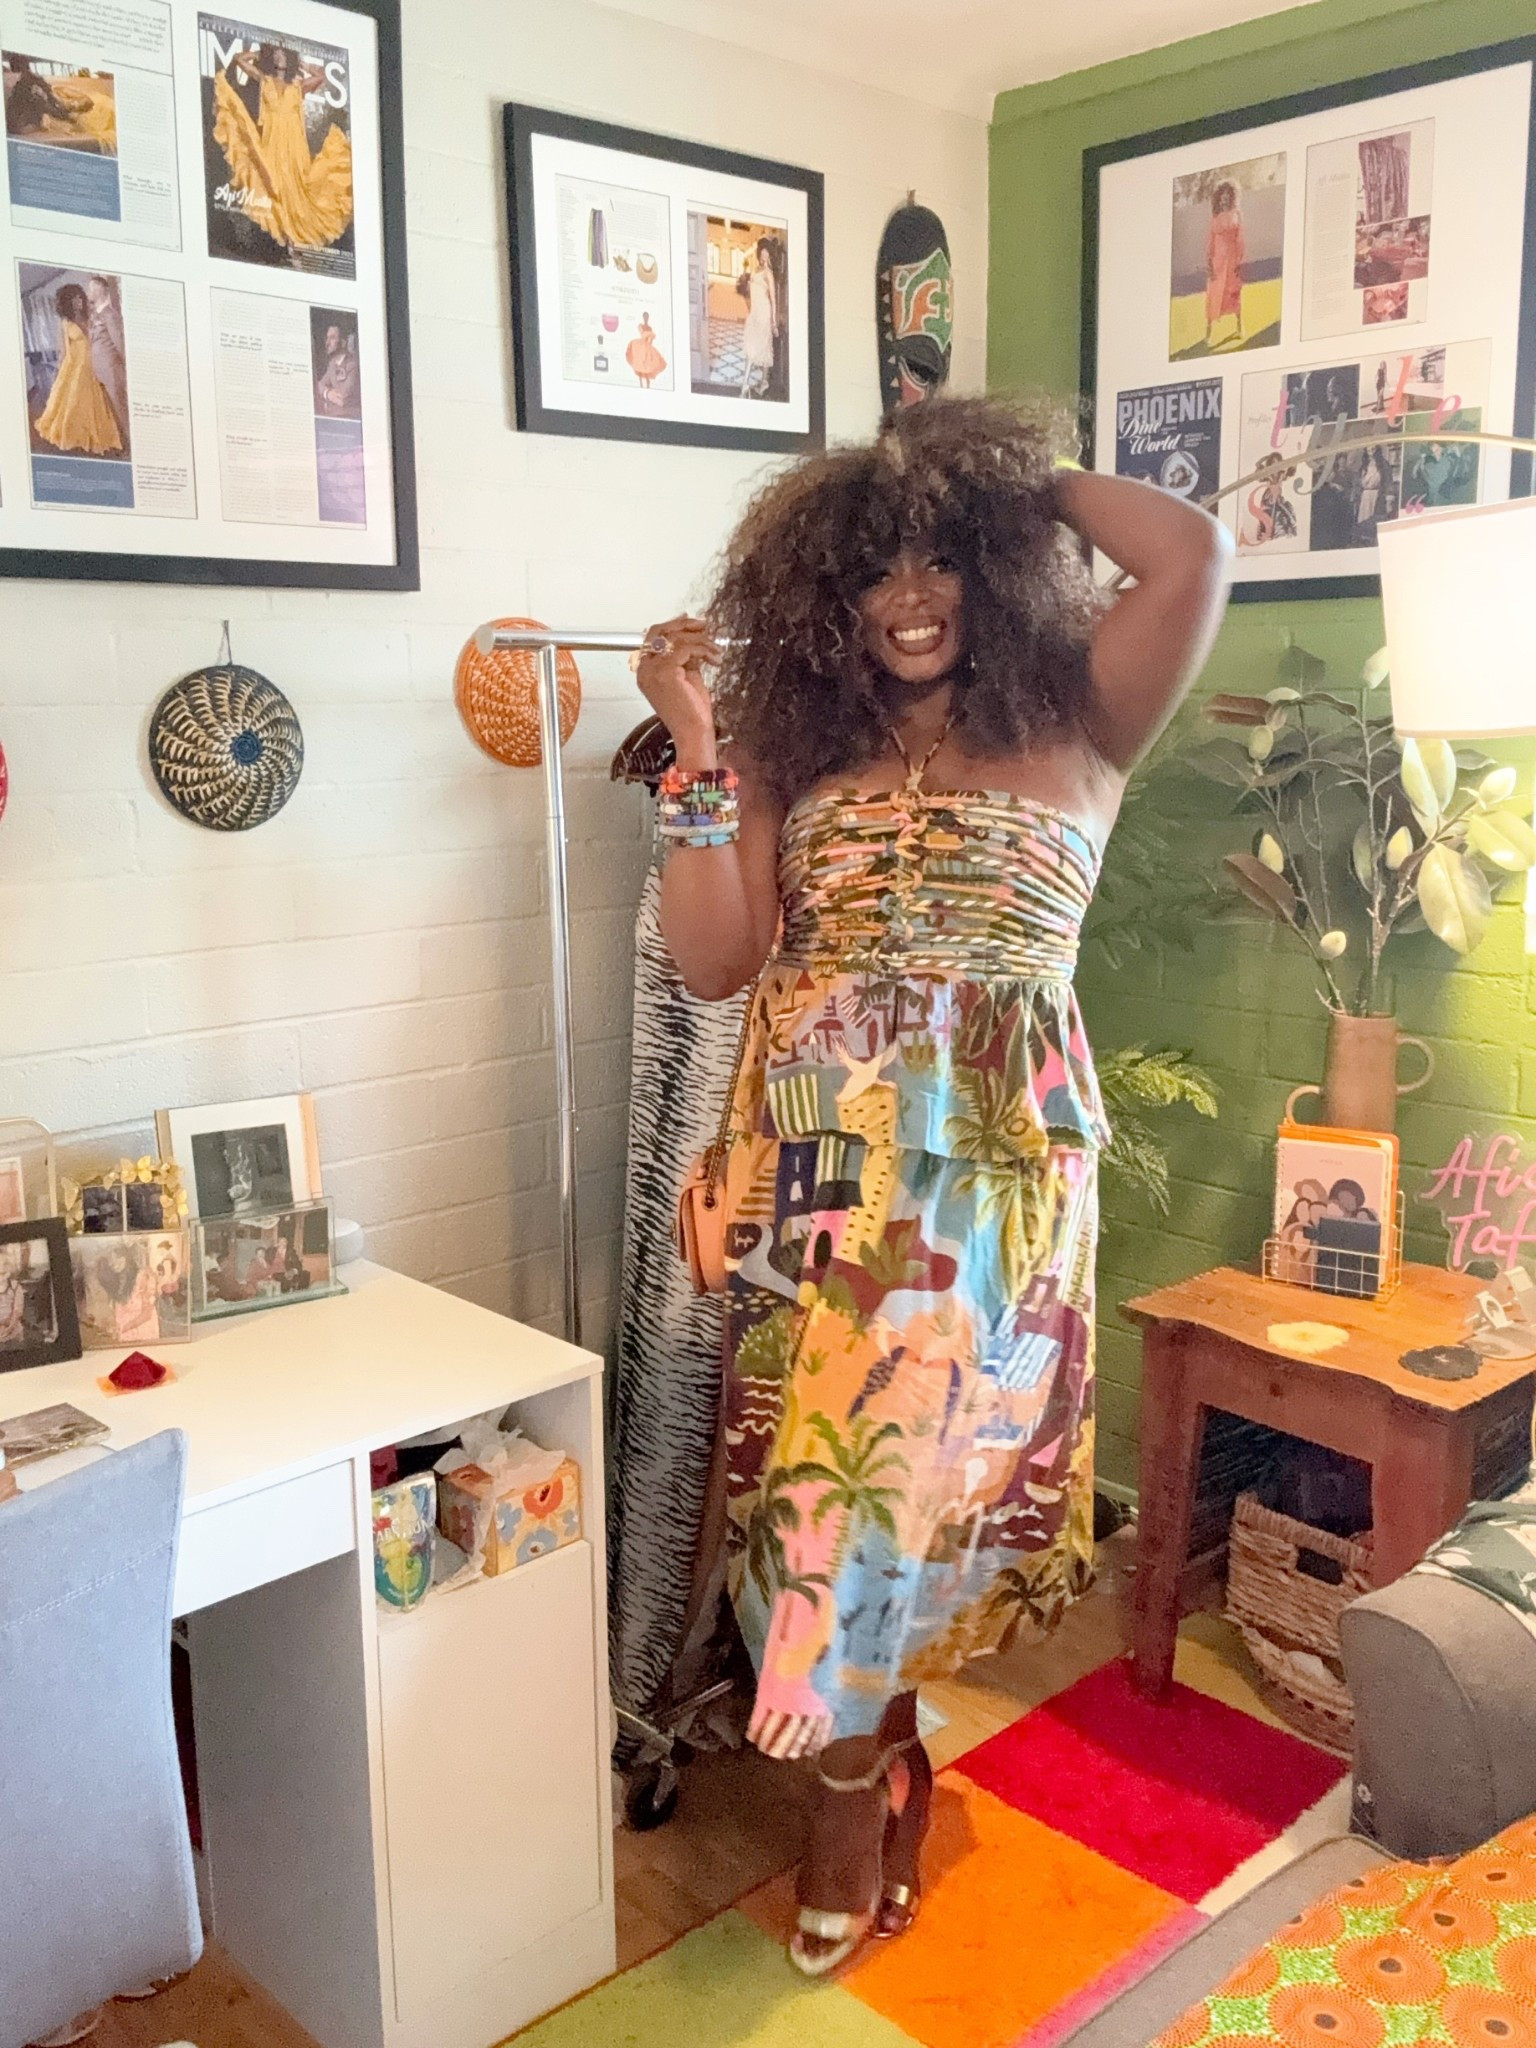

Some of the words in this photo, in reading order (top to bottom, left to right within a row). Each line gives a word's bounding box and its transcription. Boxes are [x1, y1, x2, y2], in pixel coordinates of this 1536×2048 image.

[1118, 386, 1221, 433] PHOENIX
[1118, 418, 1161, 440] Dine
[1130, 434, 1181, 455] World
